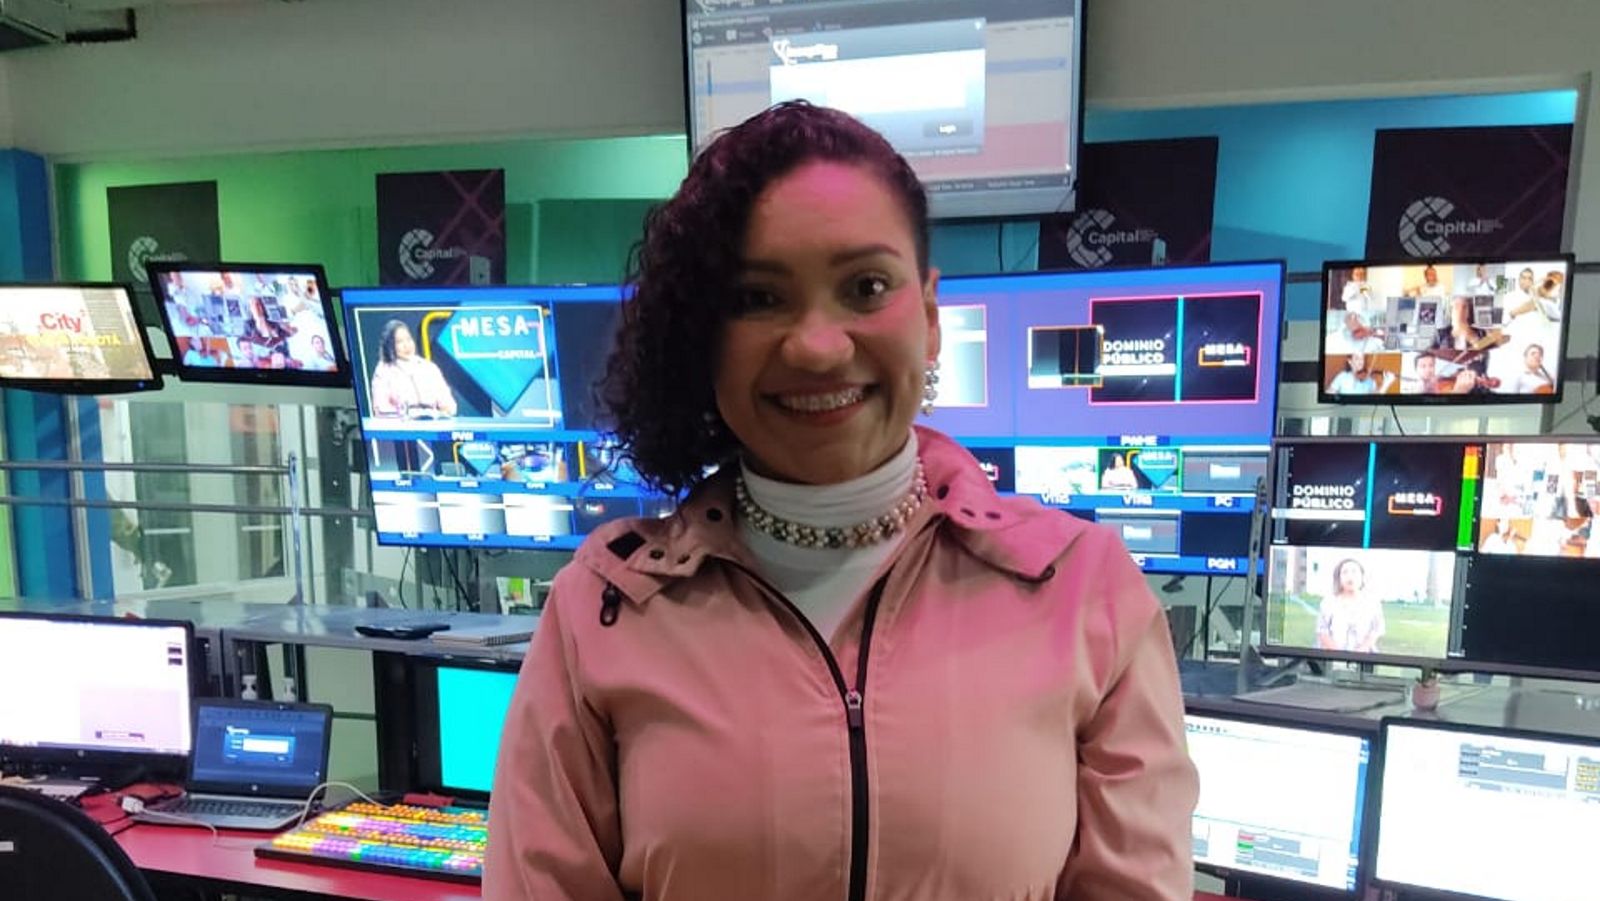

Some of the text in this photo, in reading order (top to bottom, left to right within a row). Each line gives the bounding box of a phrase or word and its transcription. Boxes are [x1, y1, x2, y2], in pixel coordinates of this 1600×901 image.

[1423, 219, 1480, 237] Capital
[1087, 230, 1139, 247] Capital
[39, 312, 82, 333] City
[460, 315, 530, 337] MESA
[1102, 339, 1165, 352] DOMINIO
[1204, 343, 1244, 355] MESA
[1102, 351, 1165, 364] PÚBLICO
[1292, 485, 1355, 497] DOMINIO
[1292, 496, 1355, 510] PÚBLICO
[1394, 492, 1435, 504] MESA
